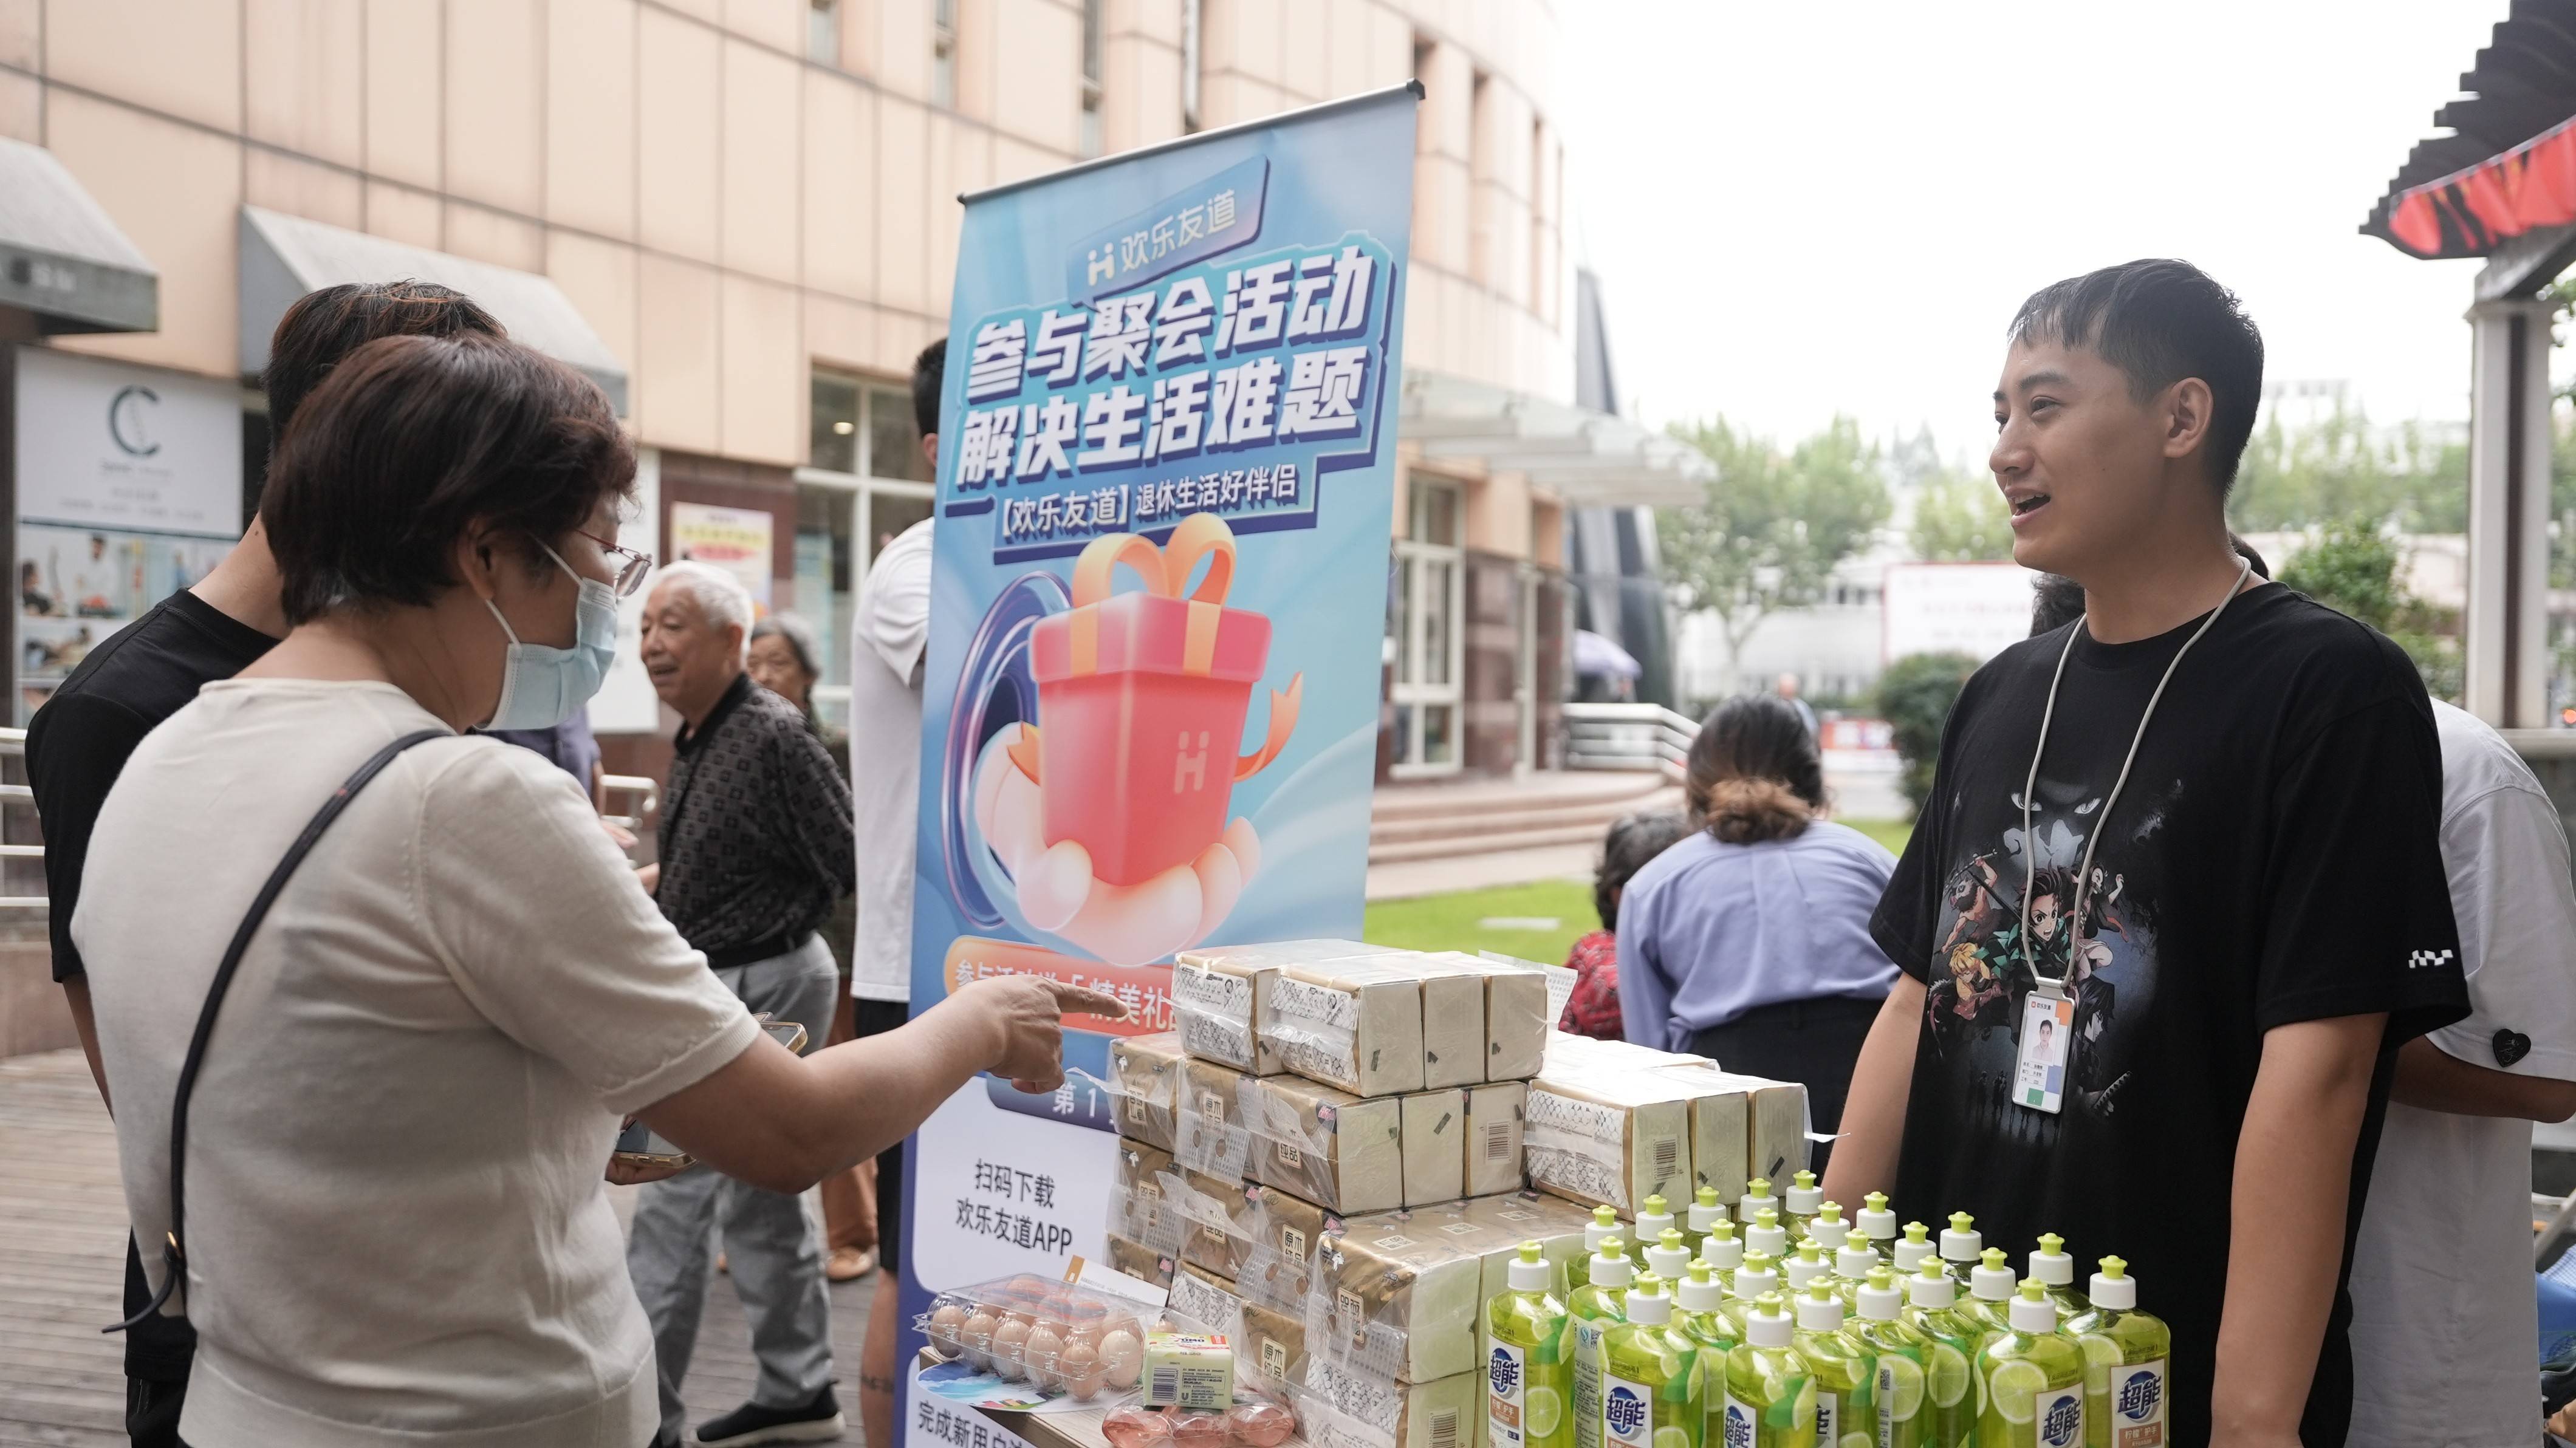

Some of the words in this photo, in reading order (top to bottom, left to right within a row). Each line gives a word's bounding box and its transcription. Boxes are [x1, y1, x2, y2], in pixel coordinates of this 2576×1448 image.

[1121, 188, 1236, 273] 欢乐友道
[967, 245, 1374, 399] 参与聚会活动
[956, 346, 1368, 485] 解决生活难题
[1135, 463, 1297, 517] 退休生活好伴侣
[975, 1158, 1055, 1209] 扫码下载
[956, 1197, 1073, 1255] 欢乐友道APP
[1285, 1231, 1303, 1252] 原木
[1264, 1343, 1283, 1367] 原木
[1490, 1354, 1519, 1387] 超能
[1606, 1393, 1646, 1429] 超能
[2117, 1375, 2162, 1413] 超能
[919, 1399, 1023, 1448] 完成新用户
[1725, 1409, 1751, 1448] 超能
[2042, 1399, 2081, 1441] 超能
